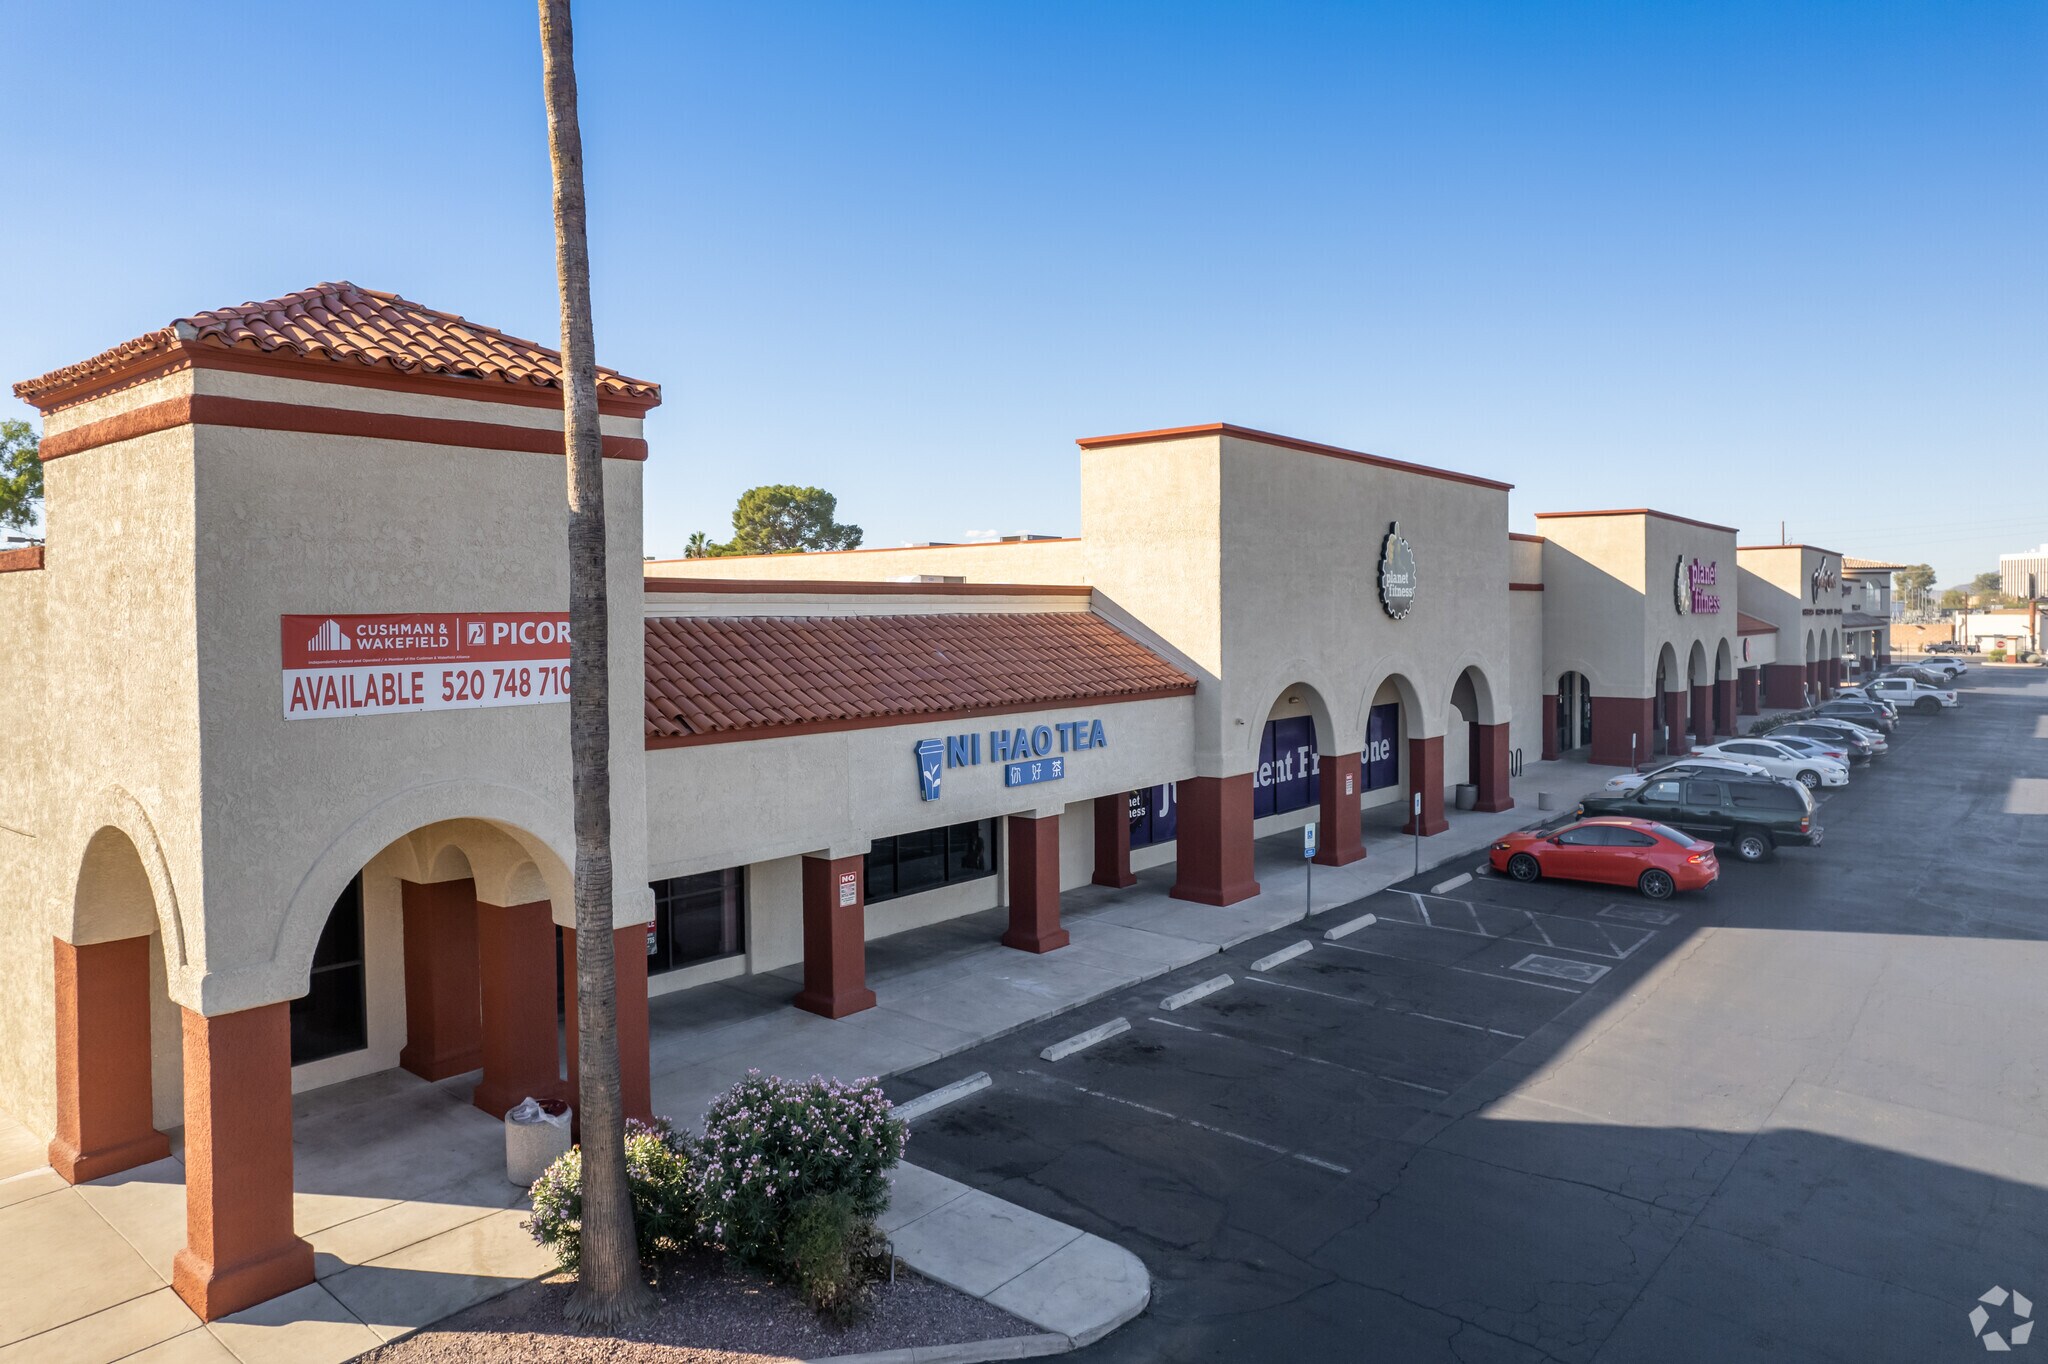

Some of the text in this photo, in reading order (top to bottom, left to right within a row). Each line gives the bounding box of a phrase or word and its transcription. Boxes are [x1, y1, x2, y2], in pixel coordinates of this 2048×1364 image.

[1386, 571, 1409, 587] planet
[1389, 584, 1413, 597] fitness
[356, 622, 448, 636] CUSHMAN &
[356, 636, 449, 650] WAKEFIELD
[290, 671, 424, 712] AVAILABLE
[442, 669, 485, 702] 520
[492, 667, 531, 699] 748
[947, 719, 1107, 768] NI HAO TEA
[1010, 760, 1062, 784] 你好茶
[841, 874, 855, 883] NO
